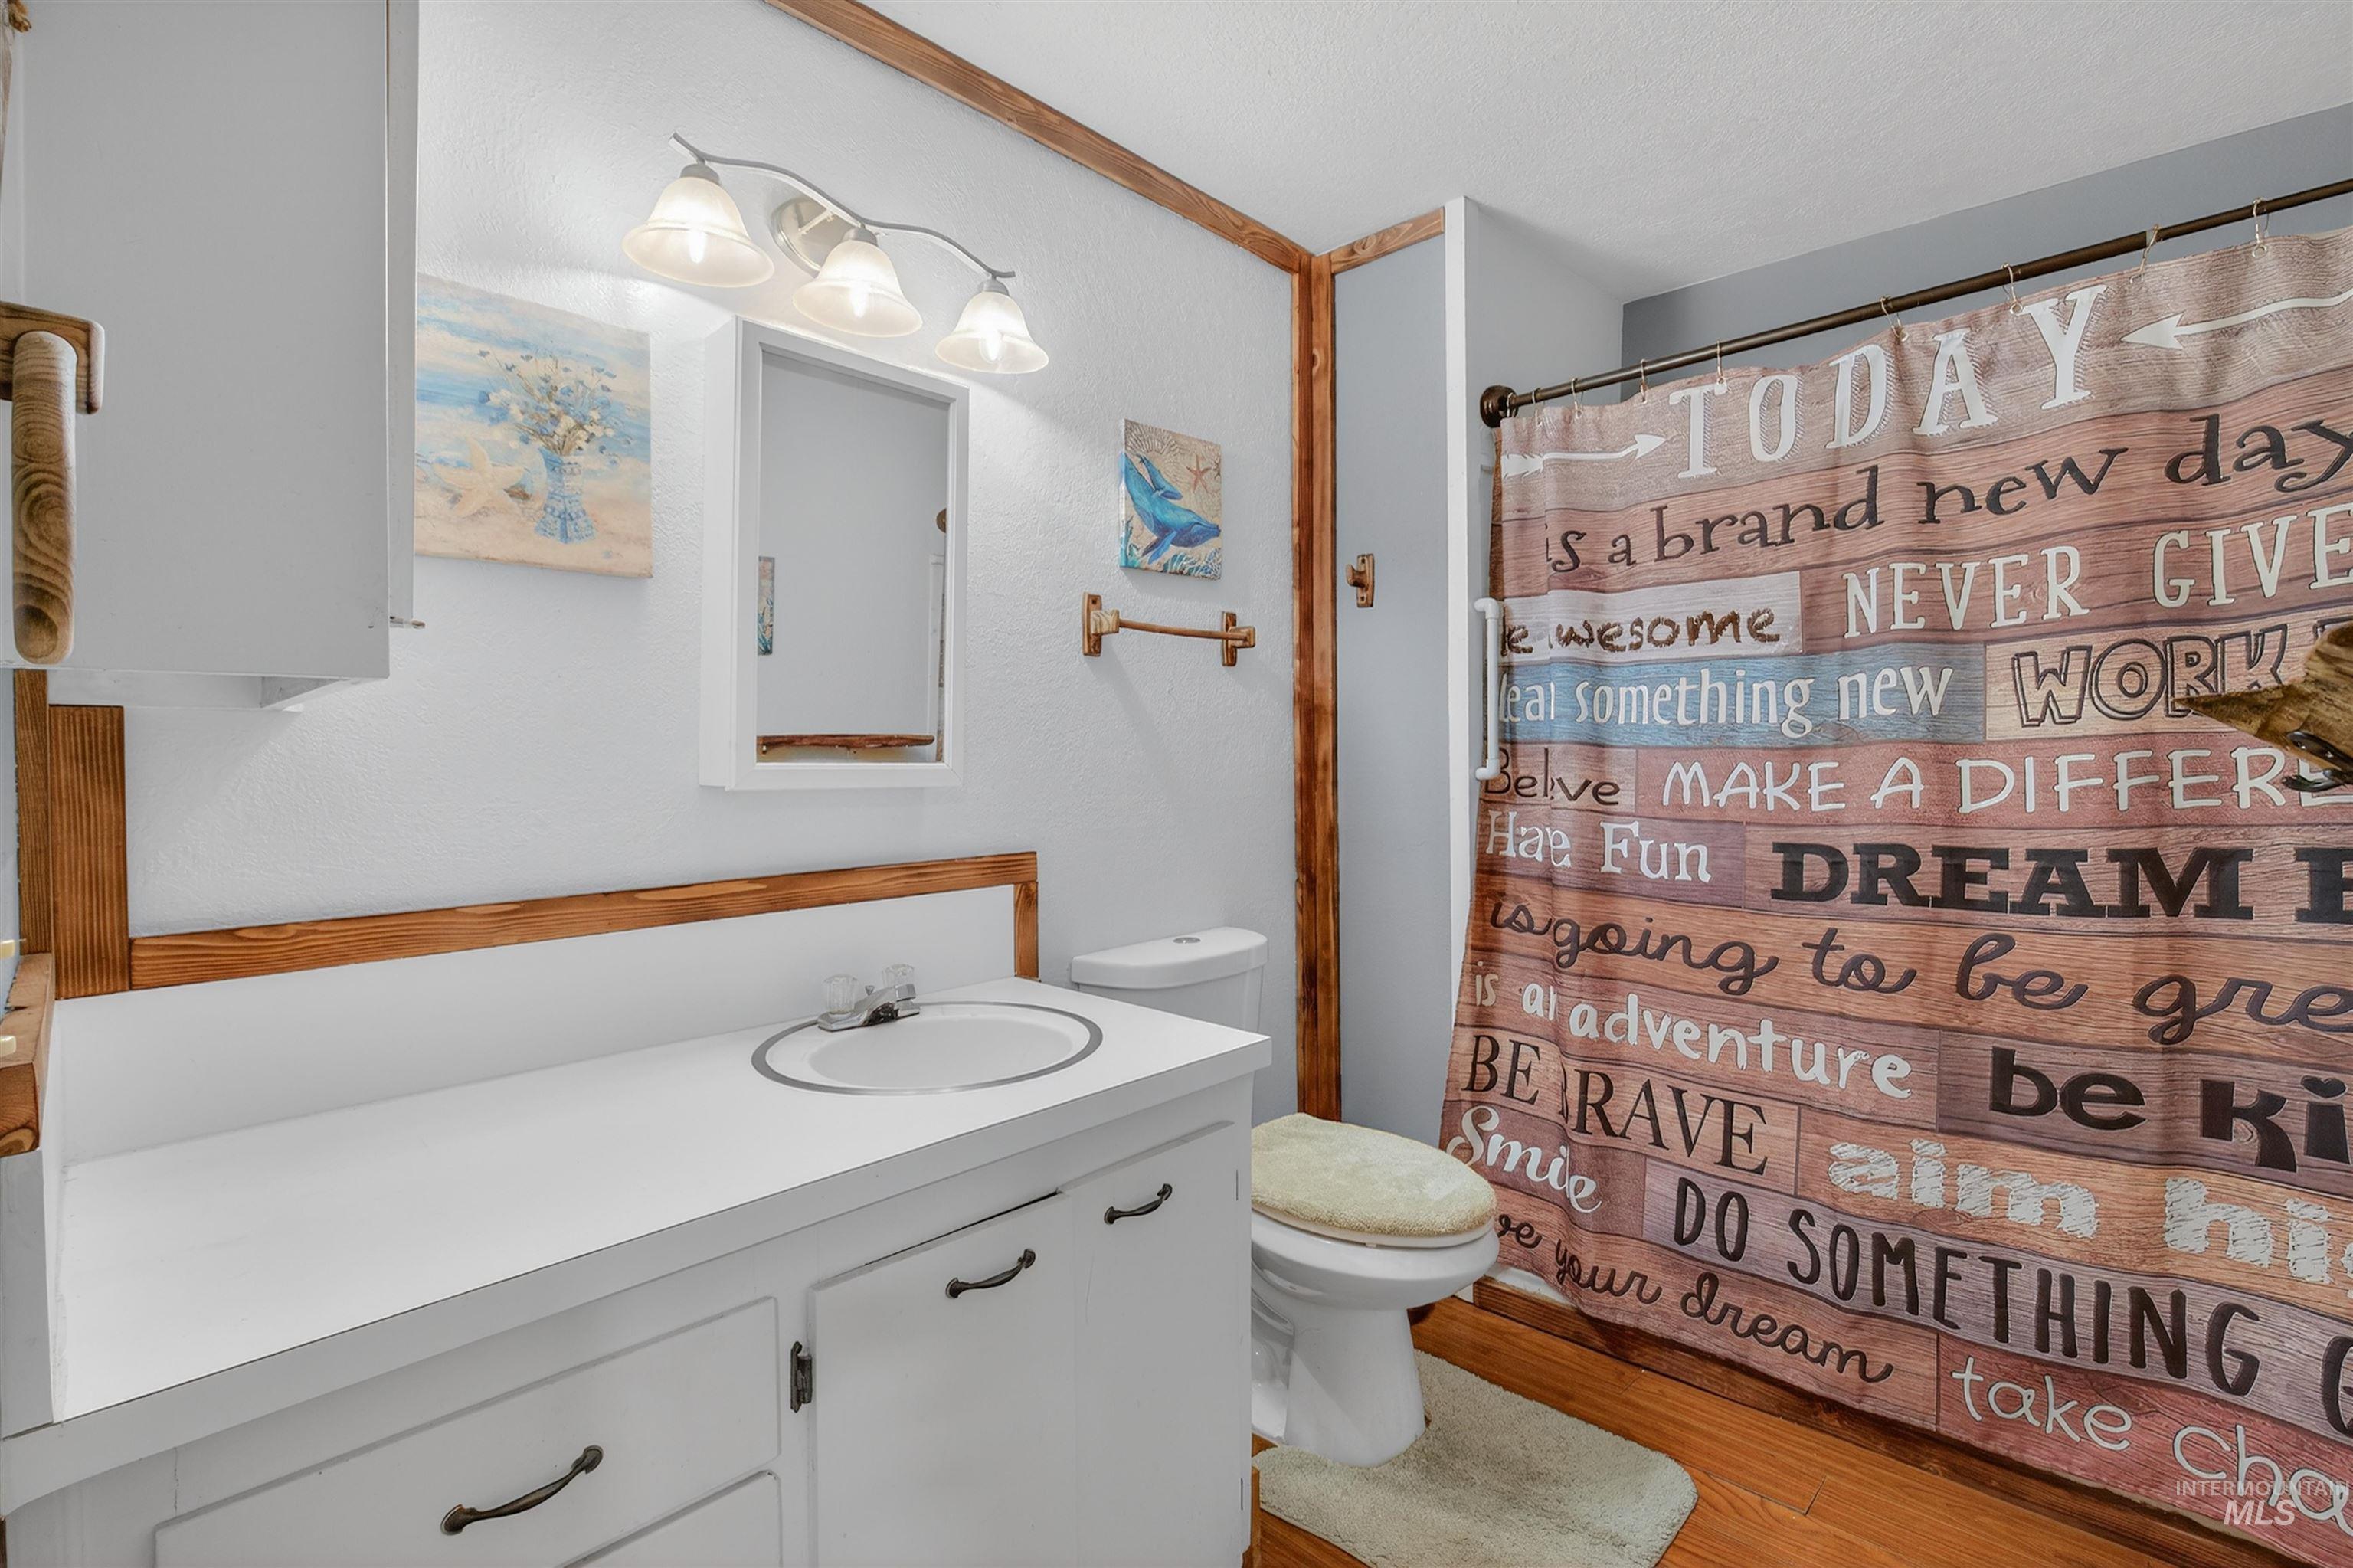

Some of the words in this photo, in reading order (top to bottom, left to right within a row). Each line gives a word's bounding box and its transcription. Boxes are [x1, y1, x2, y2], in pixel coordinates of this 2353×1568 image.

[1669, 285, 2109, 479] TODAY
[1608, 534, 1637, 566] a
[1650, 465, 1885, 563] brand
[1916, 447, 2129, 524] new
[2164, 413, 2353, 493] day
[1843, 545, 2090, 639] NEVER
[2153, 502, 2353, 608] GIVE
[1576, 668, 1815, 739] something
[1838, 666, 1953, 716] new
[2012, 624, 2289, 728] WORK
[1663, 761, 1846, 812] MAKE
[1870, 756, 1925, 809] A
[1599, 820, 1713, 883] Fun
[1771, 841, 2253, 920] DREAM
[1552, 918, 1779, 996] going
[1802, 928, 1917, 994] to
[1956, 933, 2089, 1010] be
[1461, 1034, 1541, 1106] BE
[1474, 961, 1500, 1007] is
[1569, 993, 1912, 1100] adventure
[1990, 1046, 2148, 1131] be
[1828, 1138, 2100, 1239] aim
[2164, 1177, 2353, 1302] hi
[1555, 1238, 1663, 1305] your
[1680, 1271, 1893, 1383] dream
[1673, 1177, 1749, 1262] DO
[1785, 1208, 2260, 1397] SOMETHING
[1952, 1356, 2132, 1452] take
